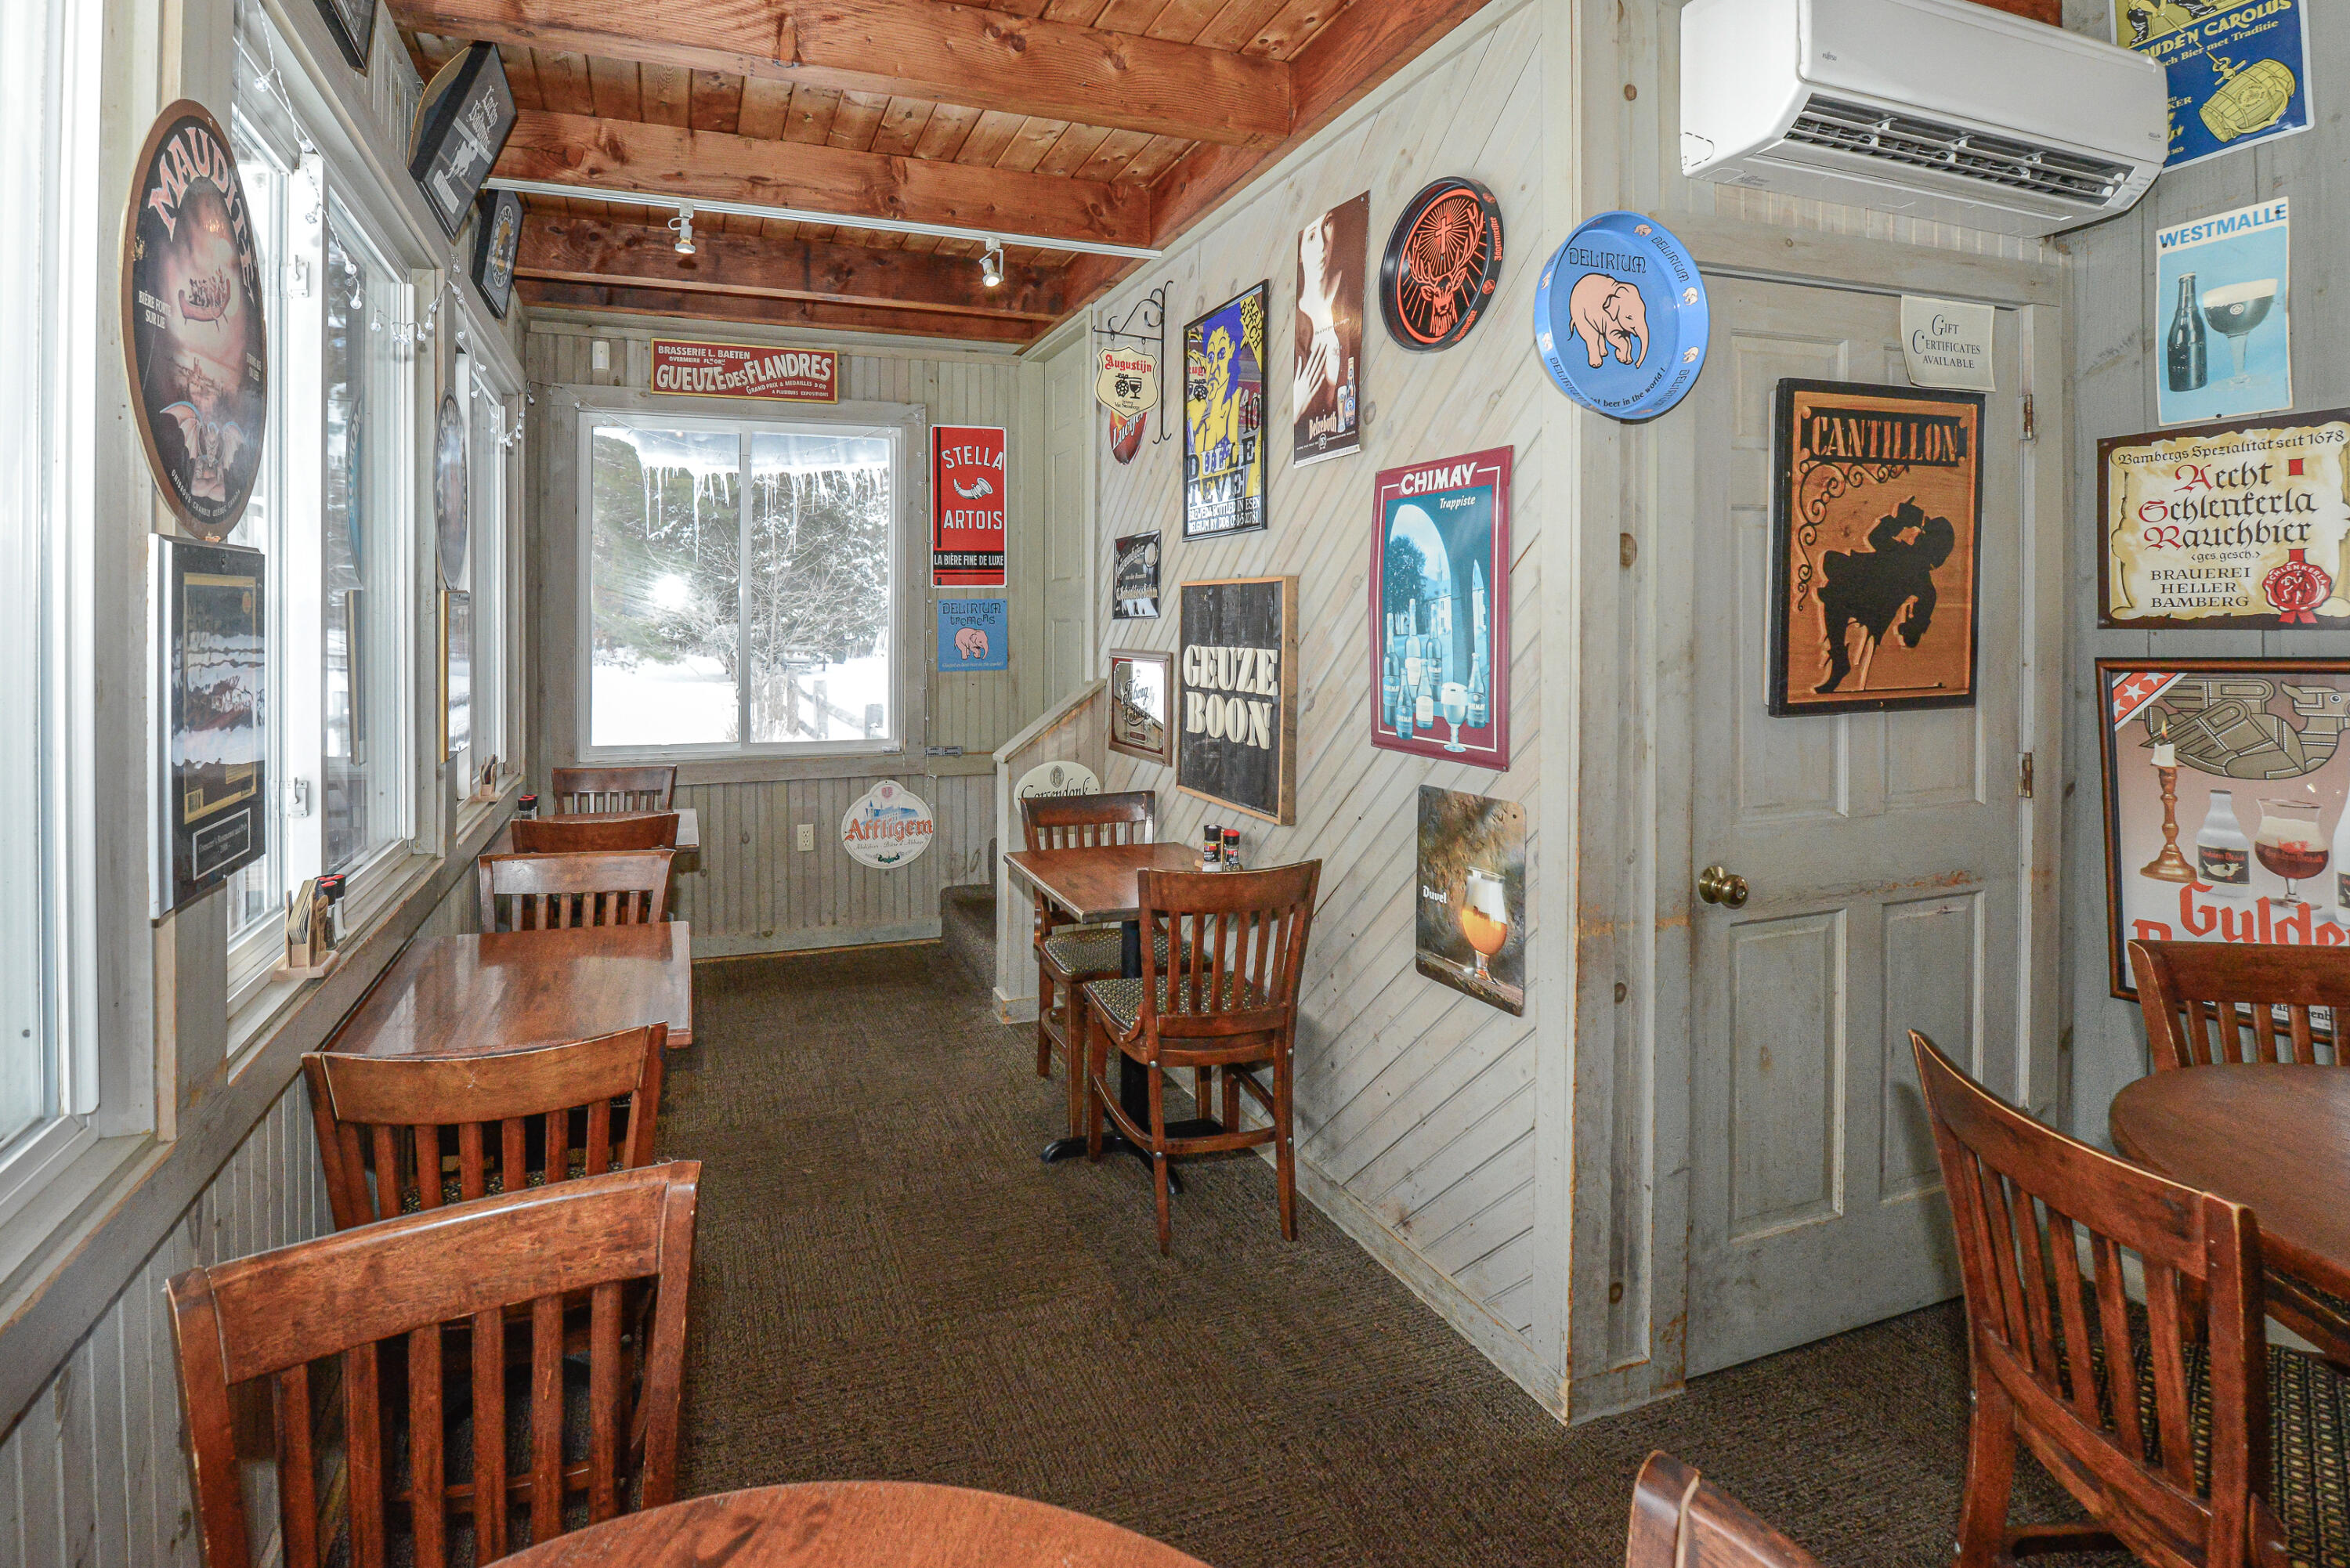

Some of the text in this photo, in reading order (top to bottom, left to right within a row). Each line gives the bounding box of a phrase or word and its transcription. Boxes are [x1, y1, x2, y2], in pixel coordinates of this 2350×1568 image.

[2139, 0, 2292, 59] OUDEN CAROLUS
[2181, 47, 2204, 60] Bier
[2207, 38, 2229, 50] met
[2231, 20, 2280, 41] Traditie
[2159, 204, 2287, 247] WESTMALLE
[1569, 247, 1647, 273] DELIRIUM
[1650, 236, 1690, 284] DELIRIUM
[1241, 301, 1262, 351] BITCH
[658, 345, 750, 360] BRASSERIE L. BAETEN
[1104, 354, 1152, 374] Augustijn
[1922, 355, 1976, 370] AVAILABLE
[656, 353, 833, 392] GUEUZE DES FLANDRES
[746, 384, 765, 395] GRAND
[1603, 398, 1620, 407] beer
[1632, 392, 1644, 403] the
[1645, 374, 1662, 394] world
[1811, 417, 1959, 462] CANTILLON
[2118, 430, 2345, 465] Bambergs Spezialität seit 1678
[942, 446, 1003, 471] STELLA
[1187, 435, 1256, 481] DULLE
[1188, 469, 1244, 508] TEVE
[1399, 461, 1477, 496] CHIMAY
[2174, 461, 2273, 493] Aecht
[1246, 496, 1260, 511] ESEN
[1439, 495, 1476, 511] Trappiste
[2138, 487, 2319, 525] Schlenkerla
[943, 509, 1003, 529] ARTOIS
[2143, 518, 2312, 551] Rauchbier
[934, 552, 1003, 566] LA BIÈRE FINE DE LUXE
[2150, 567, 2251, 581] BRAUEREI
[2160, 582, 2237, 594] HELLER
[2266, 564, 2329, 586] SCHLENKERLA
[942, 601, 1001, 615] DELIRIUM
[2150, 596, 2249, 609] BAMBERG
[950, 613, 996, 626] tremens
[1183, 644, 1278, 696] GEUZE
[1186, 691, 1273, 750] BOON
[844, 818, 933, 843] Affligem
[1423, 885, 1447, 904] Duvel
[2179, 880, 2350, 945] Gulde
